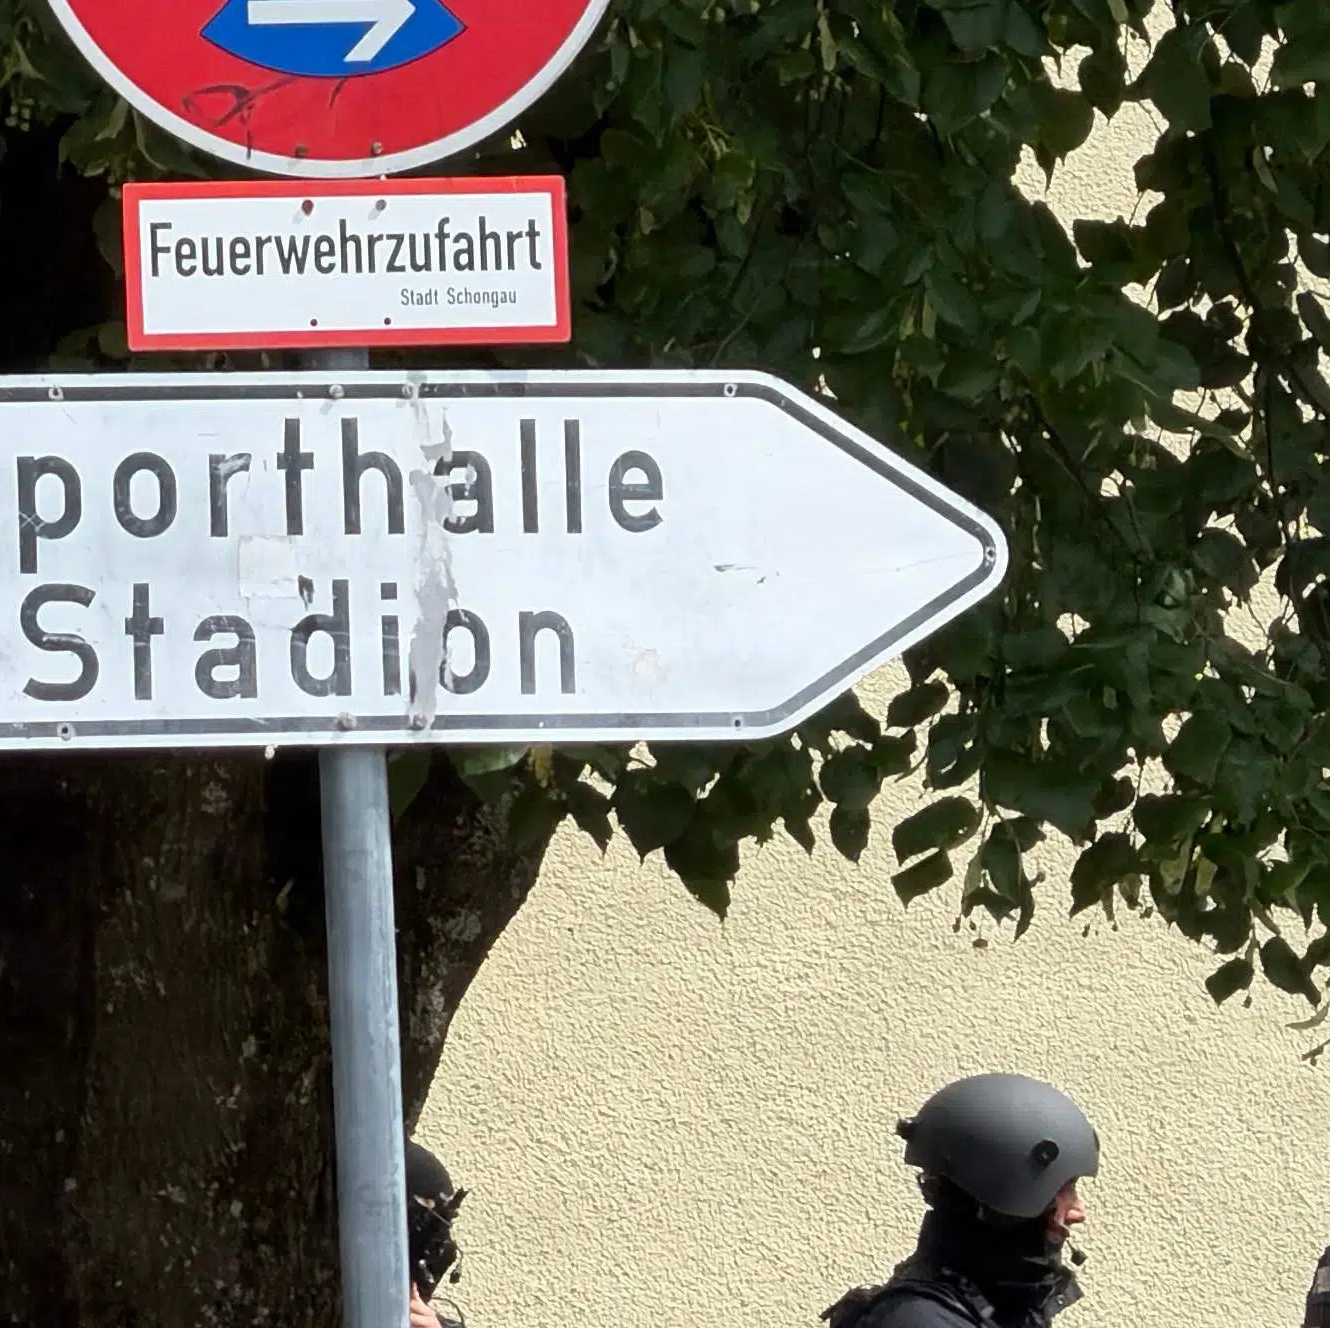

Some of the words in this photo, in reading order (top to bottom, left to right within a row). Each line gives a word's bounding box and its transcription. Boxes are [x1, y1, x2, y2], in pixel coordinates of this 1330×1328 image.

[149, 216, 542, 277] Feuerwehrzufahrt
[400, 287, 439, 306] Stadt
[446, 286, 517, 308] Schongau
[20, 579, 578, 701] Stadion
